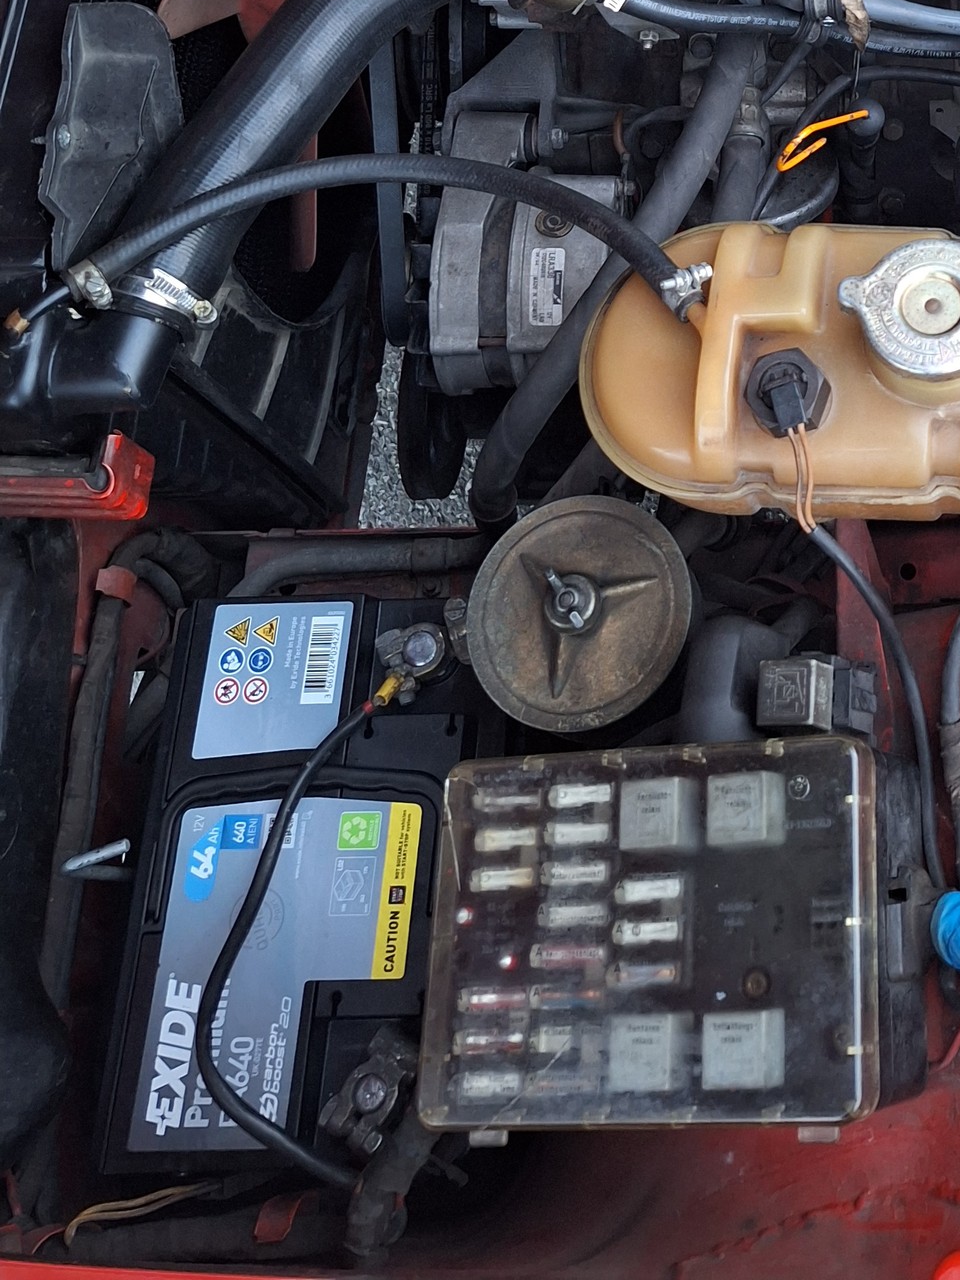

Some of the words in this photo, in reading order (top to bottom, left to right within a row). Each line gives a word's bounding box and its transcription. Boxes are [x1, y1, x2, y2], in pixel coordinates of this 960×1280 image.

[284, 651, 292, 668] Made
[289, 616, 298, 643] Europe
[290, 680, 297, 689] by
[294, 616, 306, 662] Technologies
[192, 814, 205, 832] 12V
[232, 821, 247, 844] 640
[246, 835, 255, 844] A
[190, 846, 216, 879] 64
[208, 826, 220, 844] Ah
[396, 840, 404, 867] SUITABLE
[384, 911, 400, 972] CAUTION
[145, 978, 202, 1136] EXIDE
[262, 1023, 279, 1092] carbon
